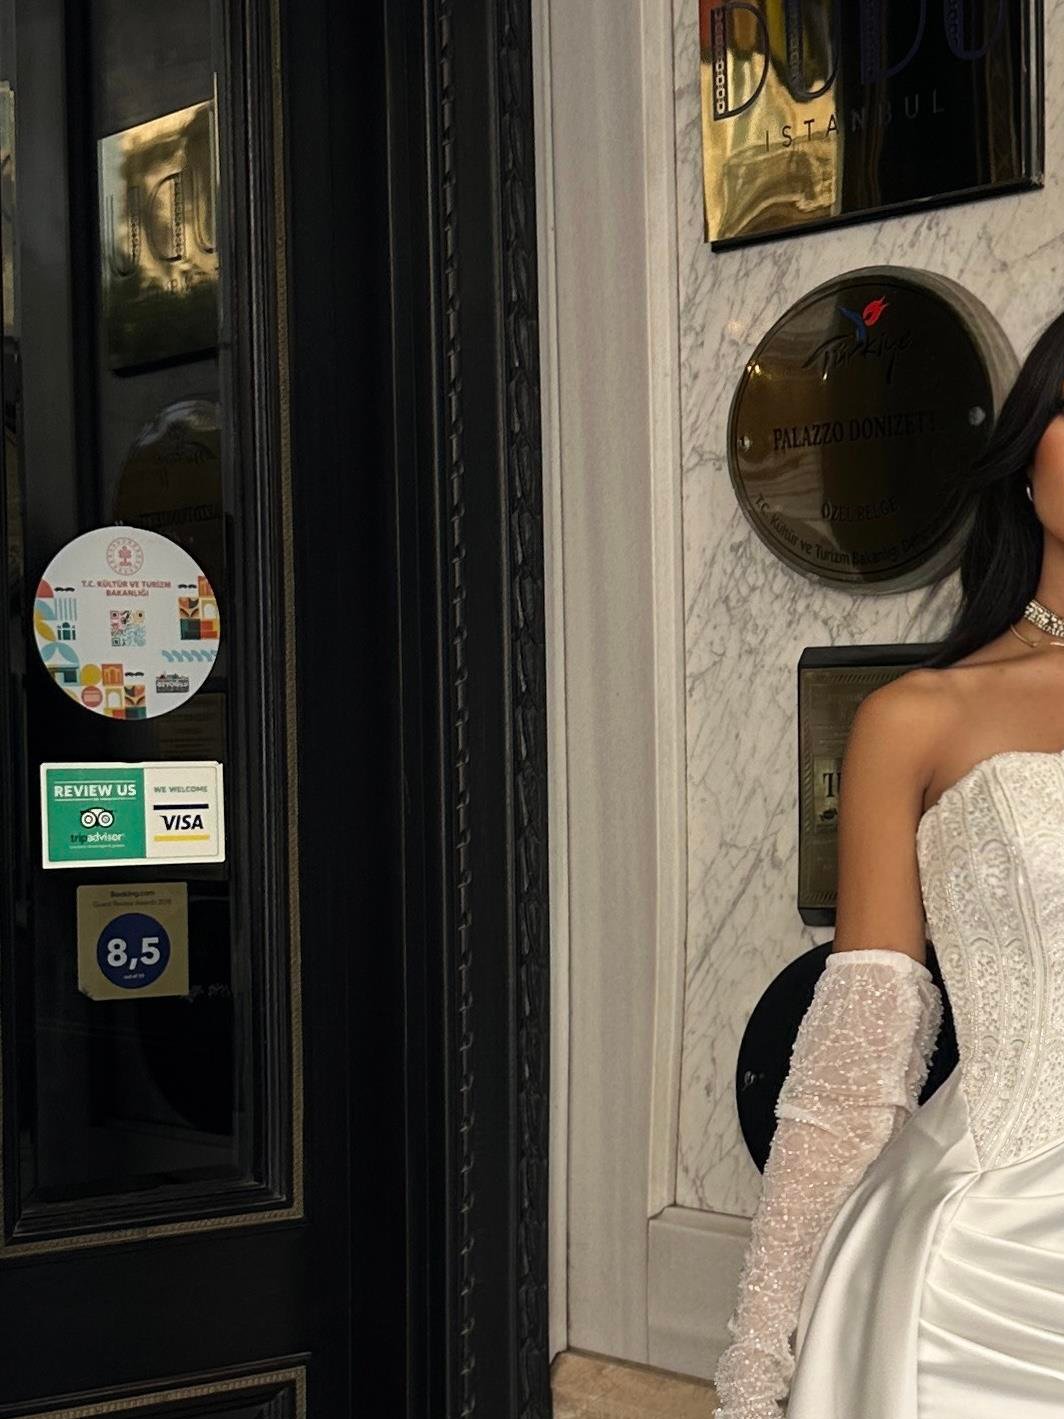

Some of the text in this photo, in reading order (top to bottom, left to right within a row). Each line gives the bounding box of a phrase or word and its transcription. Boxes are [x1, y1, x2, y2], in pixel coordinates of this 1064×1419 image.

[765, 88, 945, 152] ISTANBUL
[773, 420, 845, 452] PALAZZO
[799, 540, 813, 556] ve
[81, 580, 96, 589] T.C.
[129, 580, 141, 588] VE
[54, 784, 137, 798] REVIEW US
[154, 785, 208, 794] WE WELCOME
[160, 814, 204, 831] VISA
[107, 936, 161, 971] 8,5
